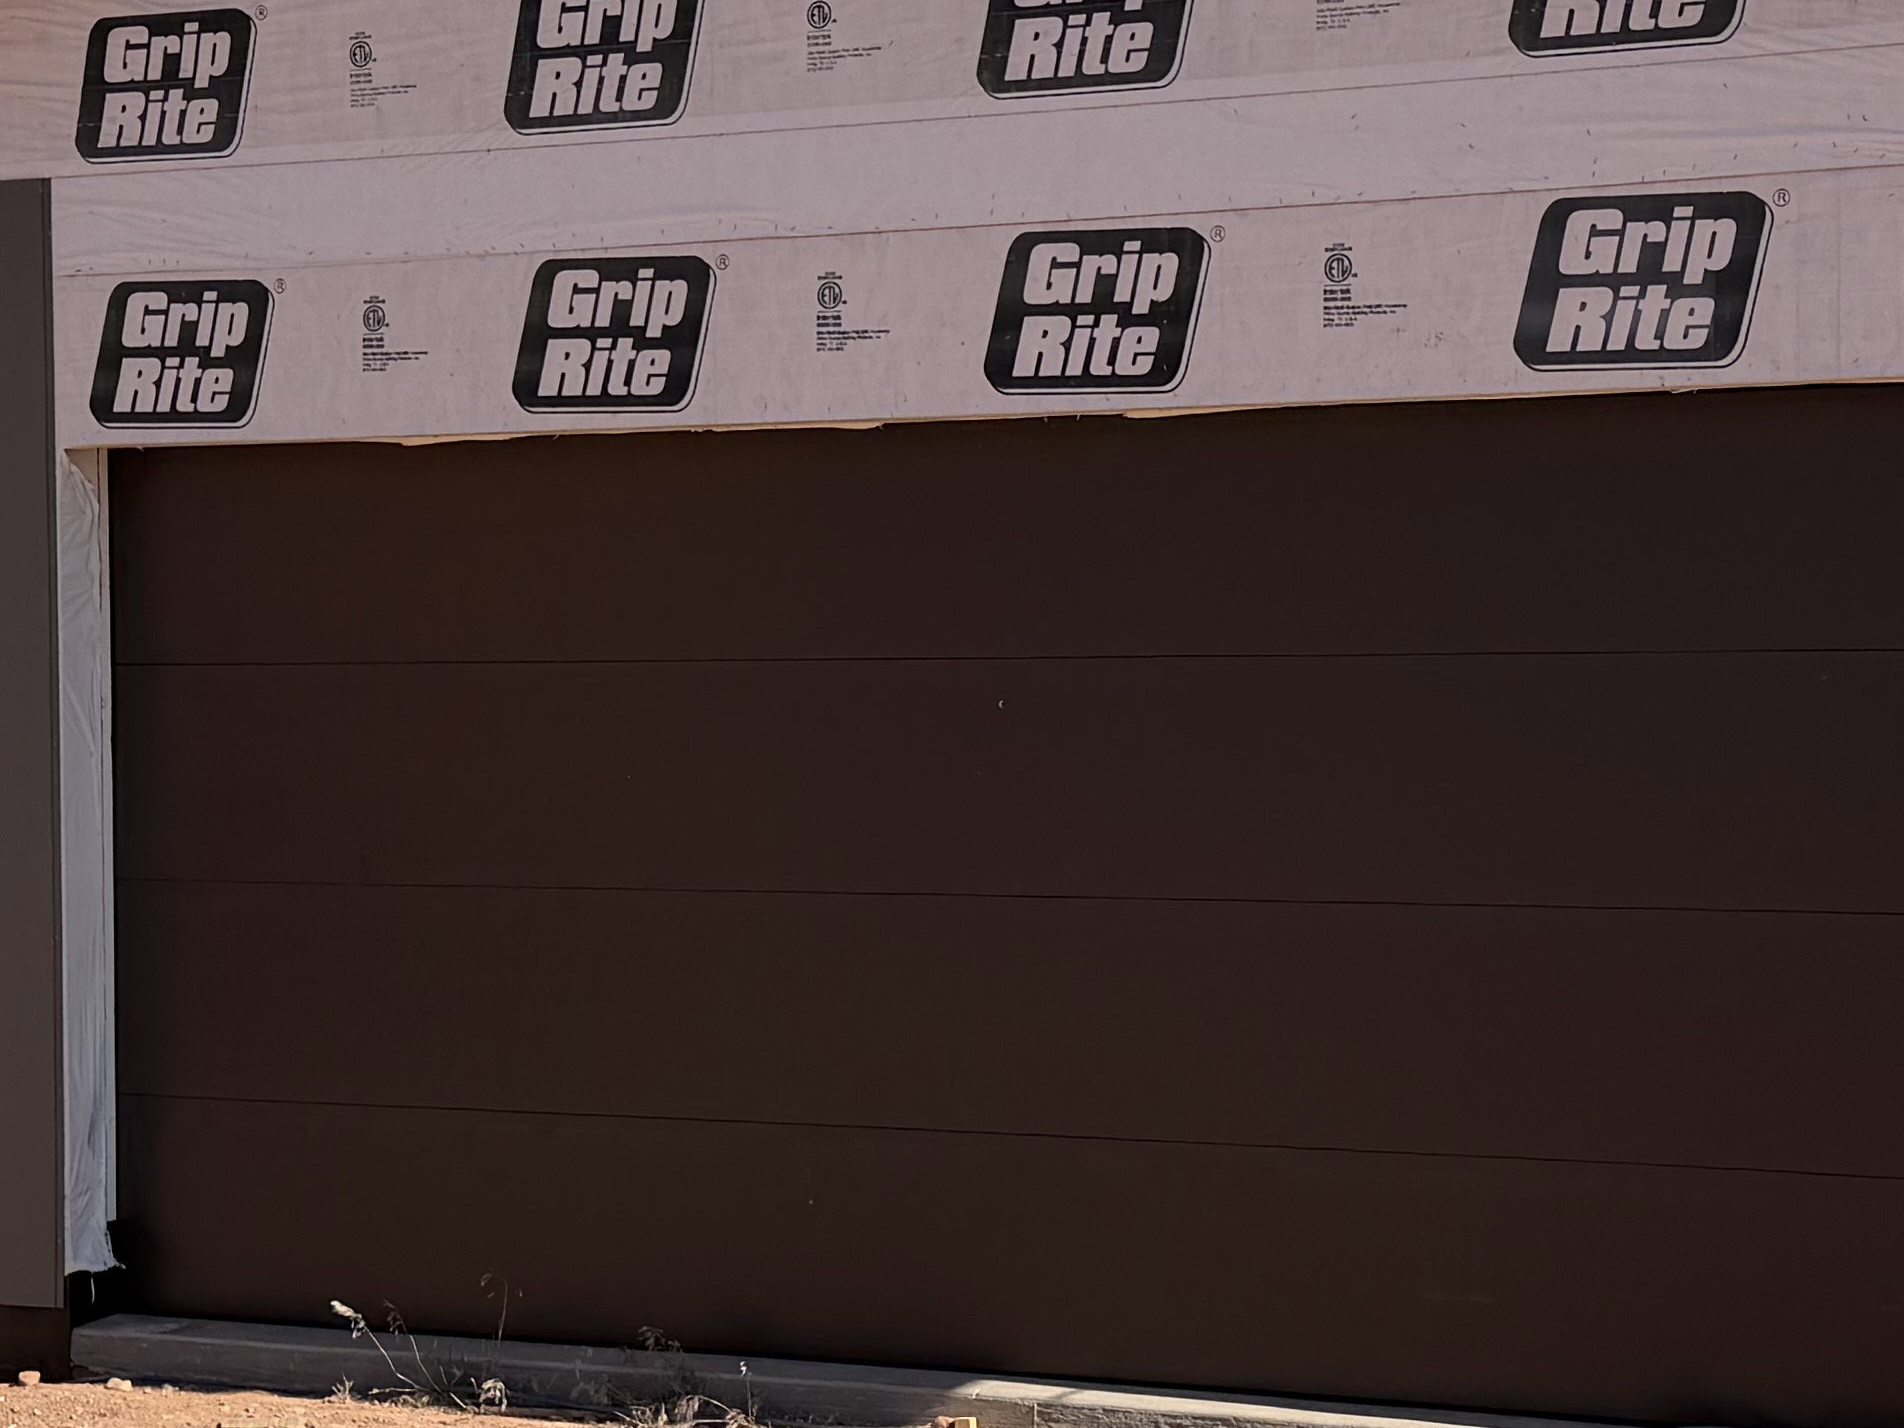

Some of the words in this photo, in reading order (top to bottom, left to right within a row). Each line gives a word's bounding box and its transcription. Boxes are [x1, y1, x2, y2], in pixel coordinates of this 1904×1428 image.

[103, 21, 232, 89] Grip
[1004, 11, 1154, 82] Rite
[97, 88, 219, 149] Rite
[528, 52, 663, 118] Rite
[1022, 240, 1179, 315] Grip
[1558, 205, 1737, 285] Grip
[121, 290, 249, 358] Grip
[547, 267, 688, 338] Grip
[1545, 284, 1715, 353] Rite
[537, 337, 672, 397] Rite
[1011, 313, 1160, 377] Rite
[112, 356, 234, 413] Rite
